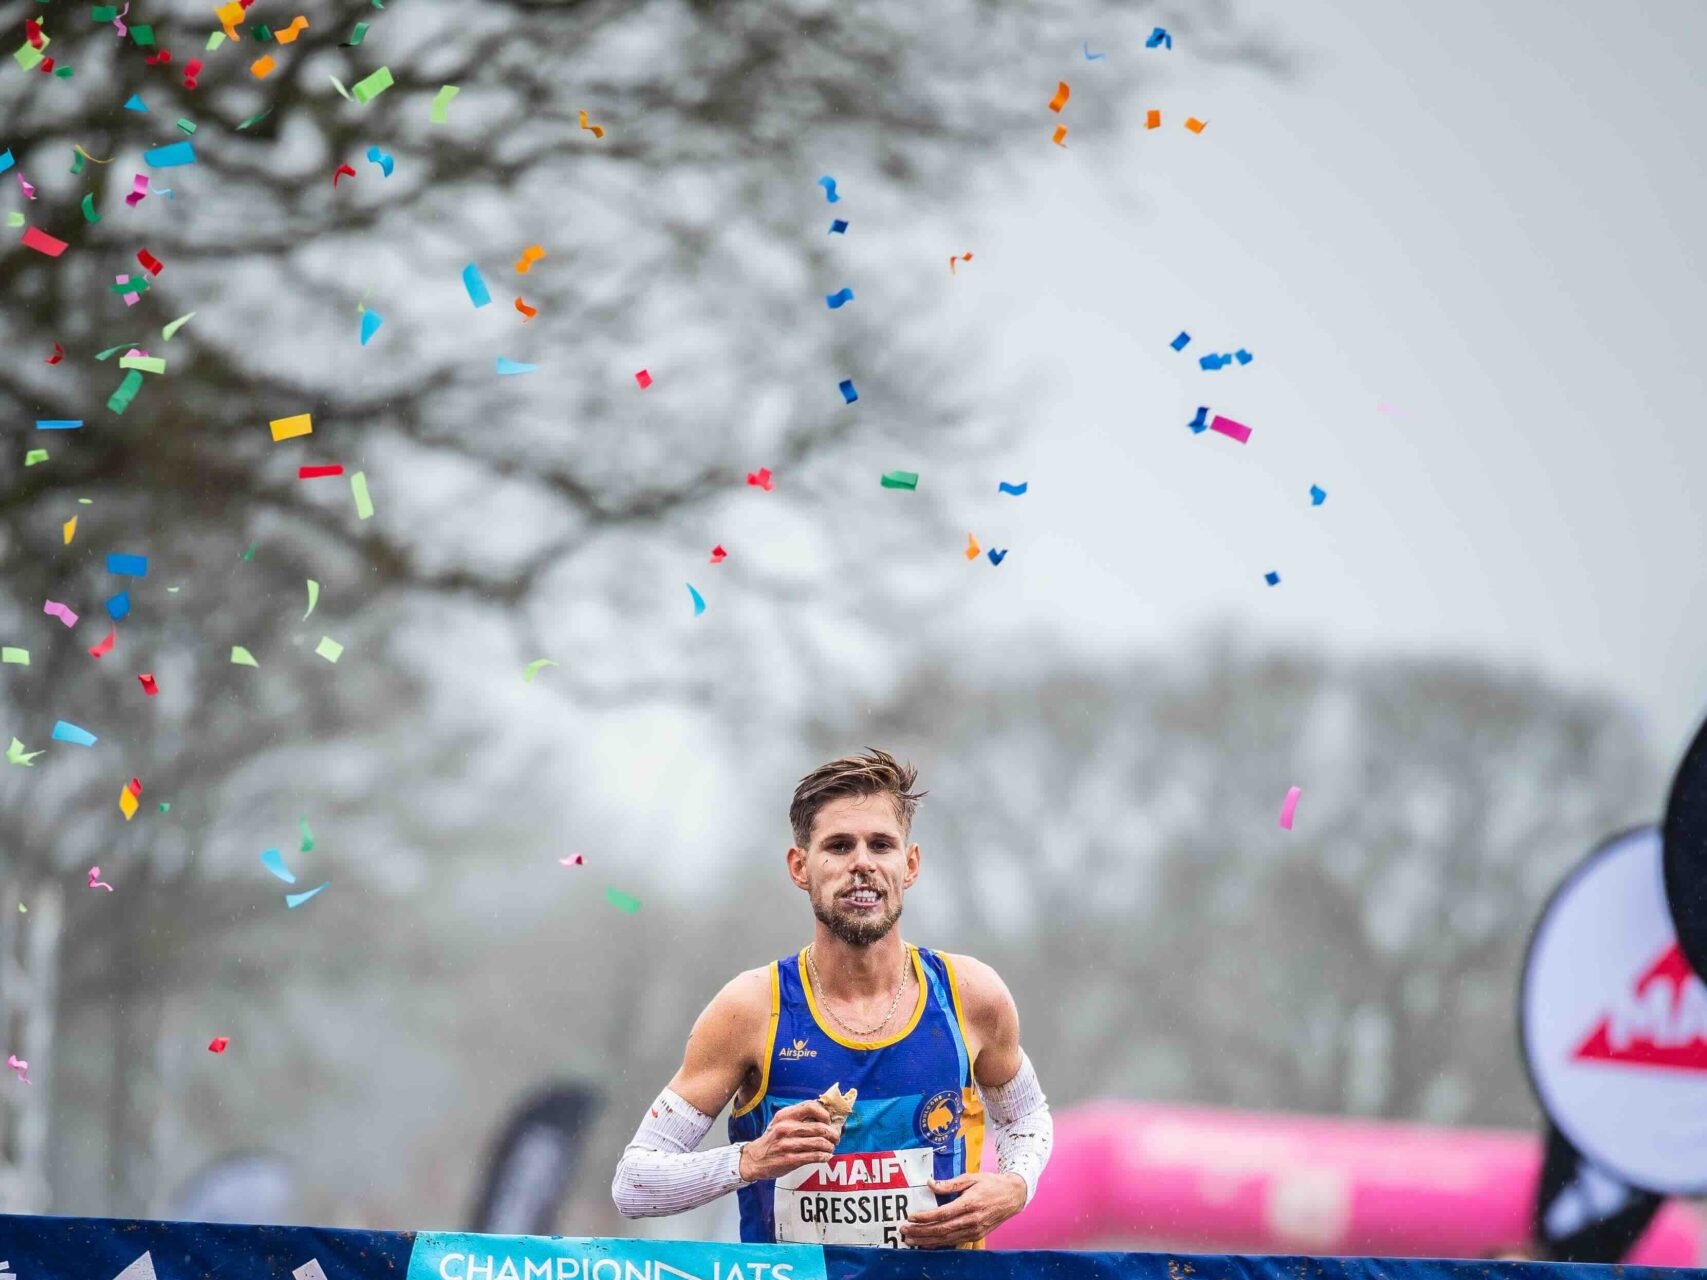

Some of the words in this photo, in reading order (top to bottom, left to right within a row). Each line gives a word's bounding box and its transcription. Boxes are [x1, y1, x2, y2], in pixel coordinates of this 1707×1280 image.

[779, 1047, 818, 1060] Airspire
[818, 1157, 900, 1186] MAIF
[800, 1194, 909, 1224] GRESSIER
